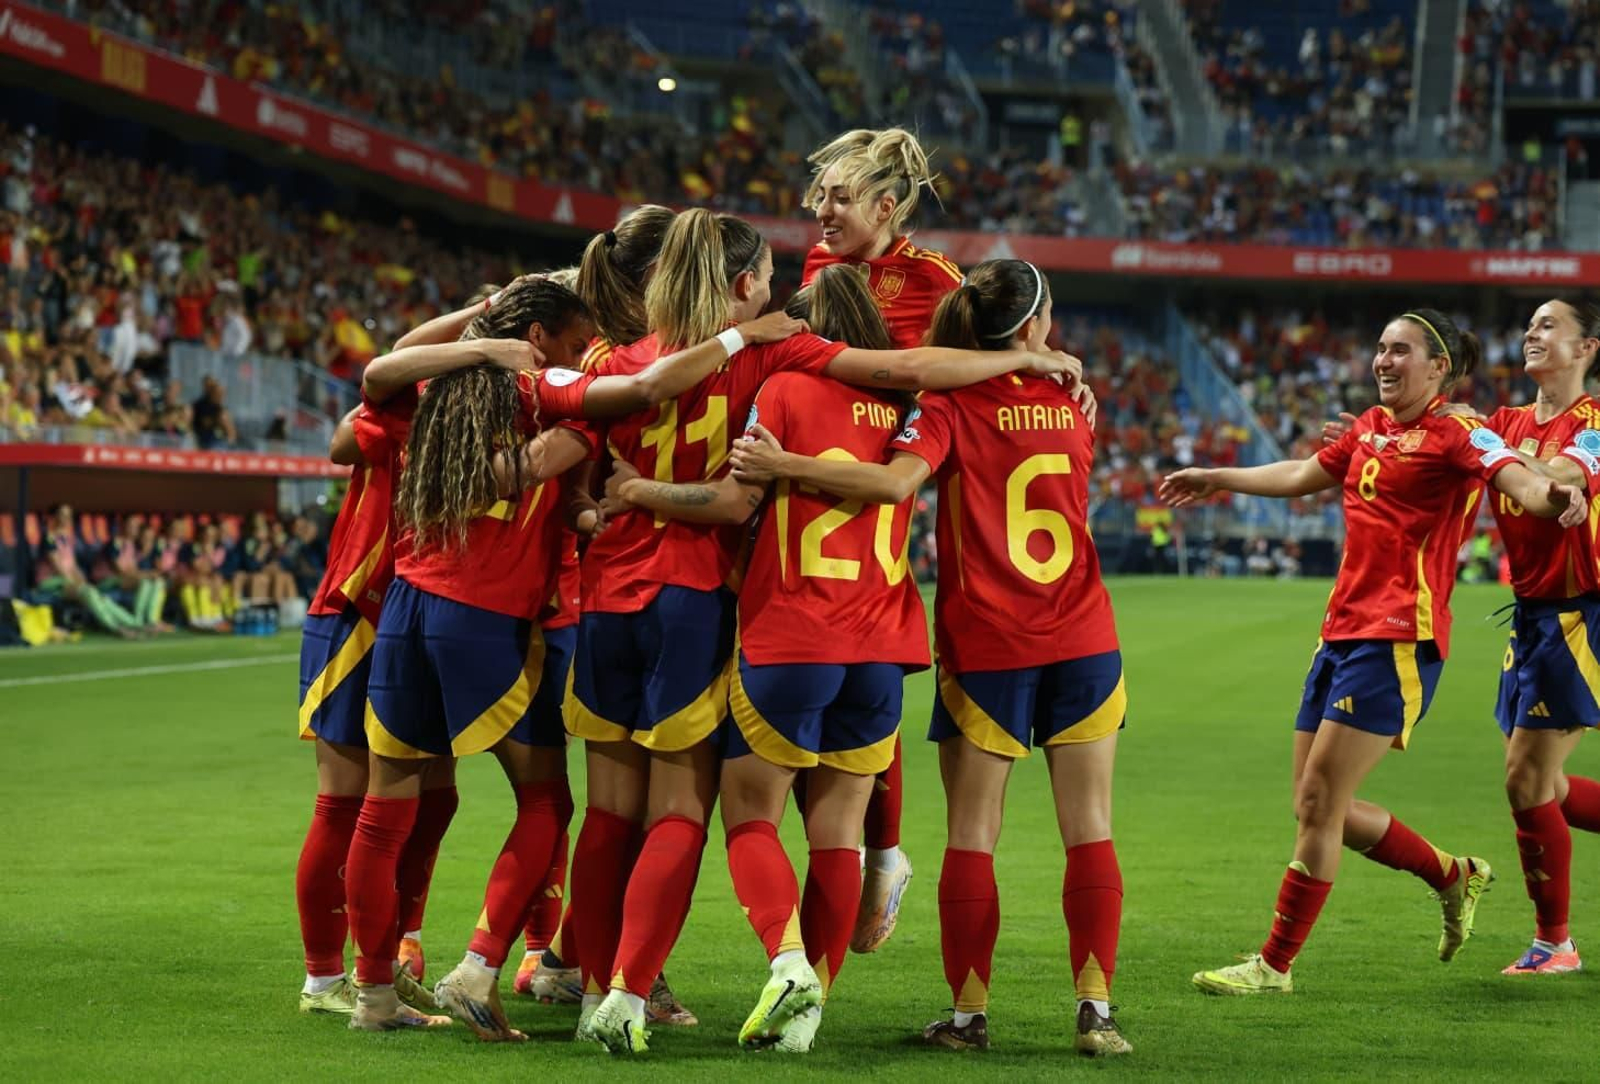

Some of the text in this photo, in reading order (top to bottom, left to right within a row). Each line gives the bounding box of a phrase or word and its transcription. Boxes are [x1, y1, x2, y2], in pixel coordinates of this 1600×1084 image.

[852, 402, 898, 430] PINA
[997, 404, 1075, 431] AITANA
[1358, 457, 1381, 502] 8
[1006, 453, 1074, 585] 6
